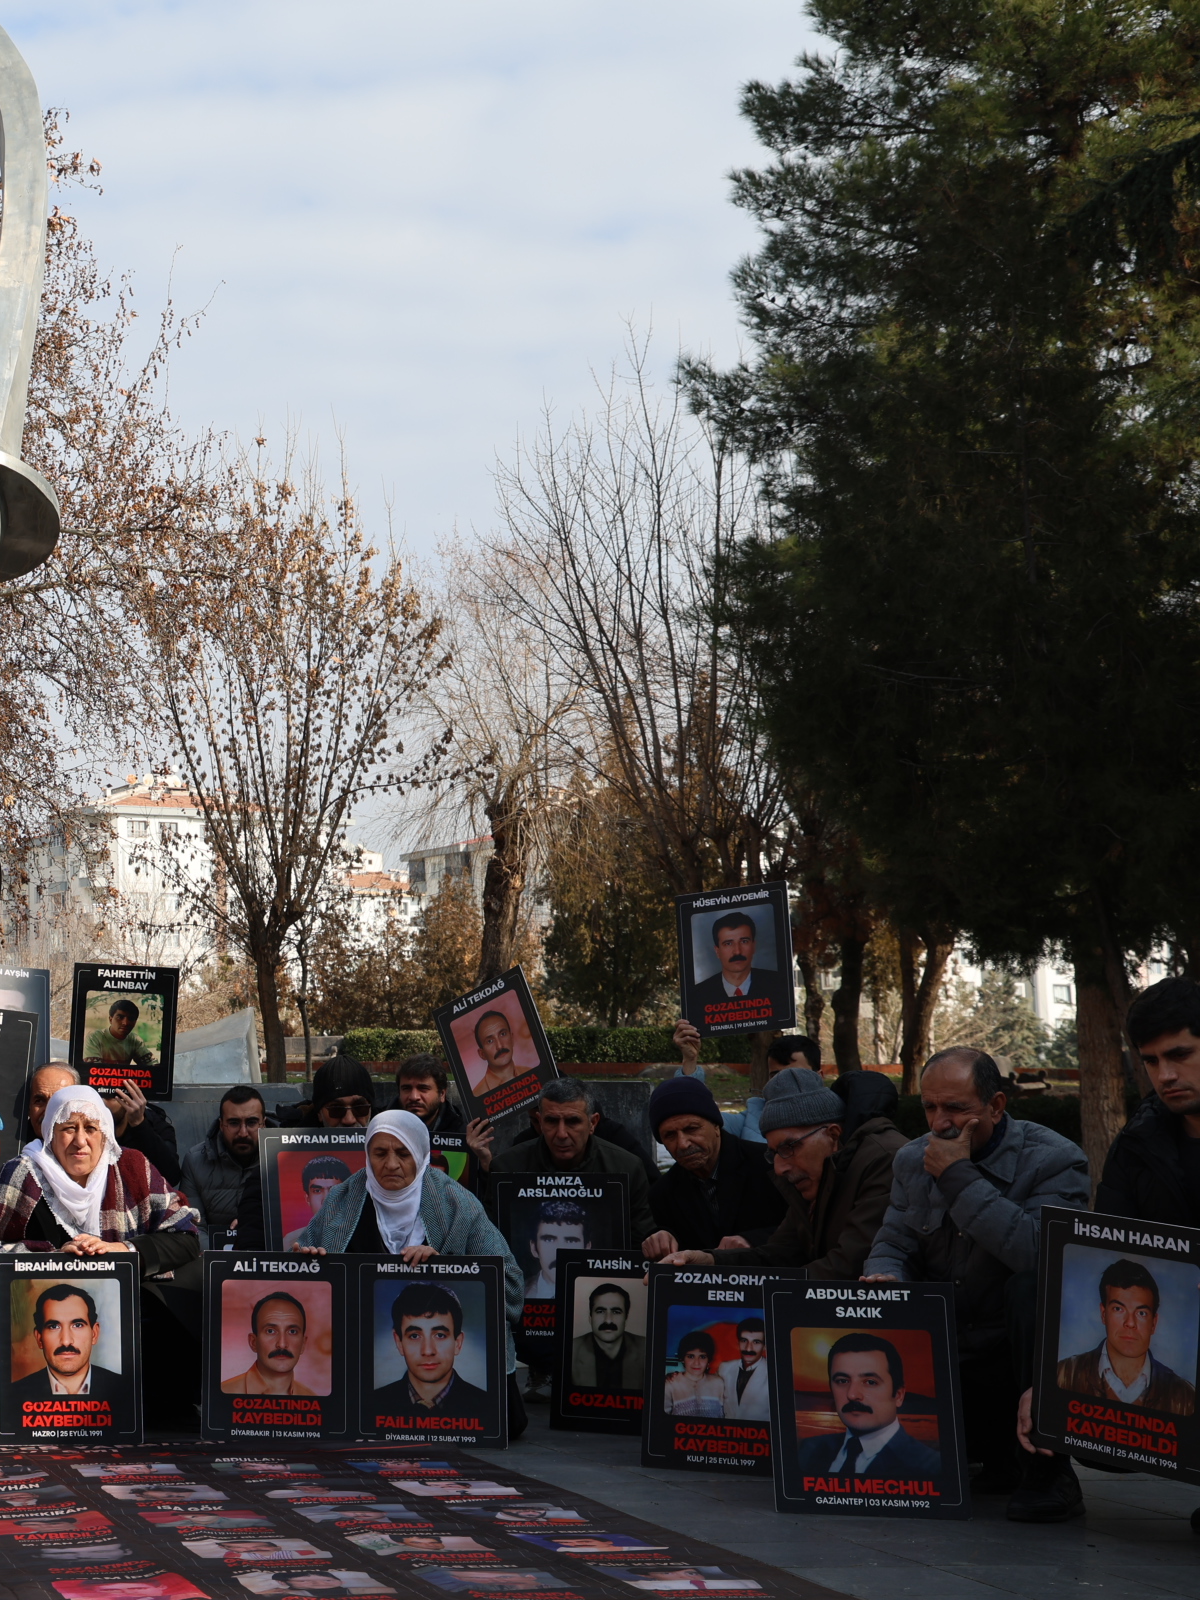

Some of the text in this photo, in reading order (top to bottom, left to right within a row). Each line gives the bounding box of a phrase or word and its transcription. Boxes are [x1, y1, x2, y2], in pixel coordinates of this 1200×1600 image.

[692, 889, 770, 909] HÜSEYİN AYDEMİR
[4, 969, 30, 978] AYŞİN
[97, 968, 156, 980] FAHRETTİN
[103, 980, 149, 991] ALINBAY
[452, 978, 505, 1014] ALİ TEKDAĞ
[704, 1008, 773, 1025] KAYBEDİLDİ
[710, 1023, 734, 1031] İSTANBUL
[281, 1135, 329, 1144] BAYRAM
[432, 1134, 462, 1147] ÖNER
[536, 1176, 583, 1186] HAMZA
[517, 1186, 603, 1198] ARSLANOĞLU
[1073, 1218, 1191, 1254] İHSAN HARAN
[14, 1259, 116, 1272] İBRAHİM GÜNDEM
[233, 1257, 321, 1273] ALİ TEKDAĞ
[376, 1262, 480, 1275] MEHMET TEKDAĞ
[586, 1257, 632, 1270] TAHSİN
[707, 1290, 744, 1302] EREN
[805, 1288, 911, 1301] ABDULSAMET
[835, 1306, 883, 1319] SAKIK
[22, 1414, 113, 1428] KAYBEDİLDİ
[231, 1411, 323, 1426] KAYBEDİLDİ
[375, 1416, 413, 1428] FAİLİ
[69, 1428, 89, 1437] EYLÜL
[230, 1428, 270, 1437] DİYARBAKIR
[283, 1430, 305, 1438] KASIM
[385, 1433, 425, 1442] DİYARBAKIR
[1066, 1418, 1179, 1458] KAYBEDİLDİ
[673, 1437, 770, 1457] KAYBEDİLDİ
[1064, 1435, 1178, 1471] DİYARBAKIR 25 ARALIK 1994
[686, 1455, 756, 1467] KULP 25 EYLÜL 1997
[802, 1476, 850, 1493] FAİLİ
[815, 1495, 930, 1509] GAZİANTEP 03 KASIM 1992
